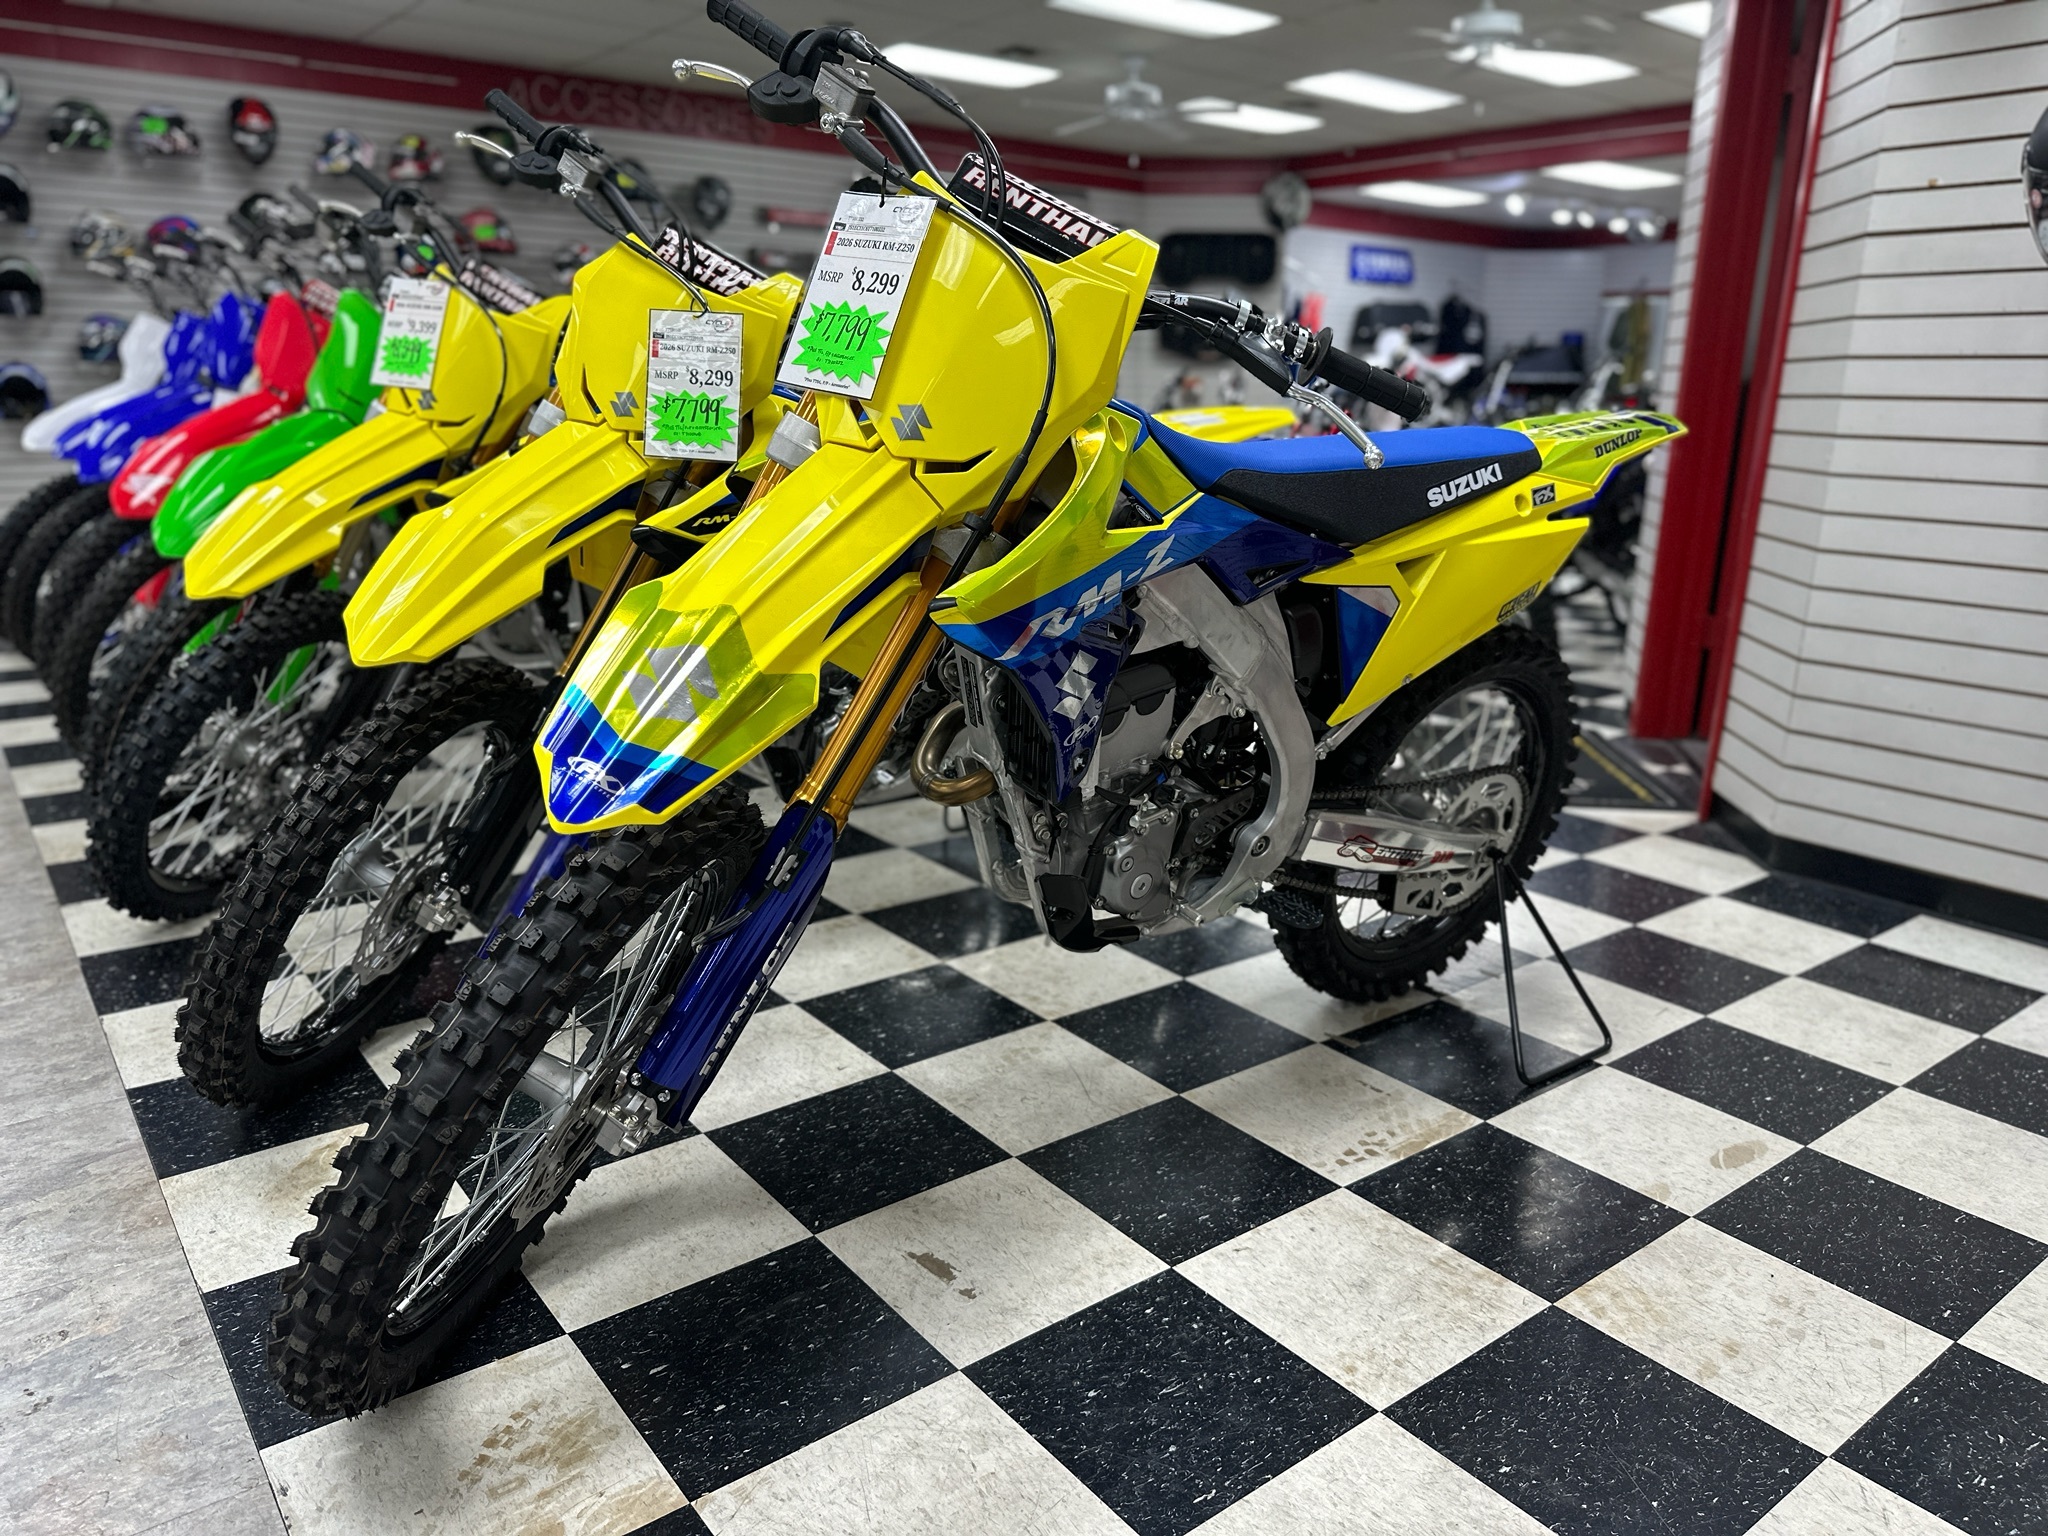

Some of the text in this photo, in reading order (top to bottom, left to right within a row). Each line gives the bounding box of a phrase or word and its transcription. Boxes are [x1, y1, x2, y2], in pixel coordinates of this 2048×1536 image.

[837, 237, 916, 253] 2026 SUZUKI RM-Z250
[818, 270, 844, 284] MSRP
[660, 343, 737, 355] 2026 SUZUKI RM-Z250
[654, 370, 679, 380] MSRP
[1594, 428, 1643, 458] DUNLOP
[1426, 462, 1503, 508] SUZUKI
[691, 513, 738, 527] RM-
[699, 921, 795, 1077] DUNLOP
